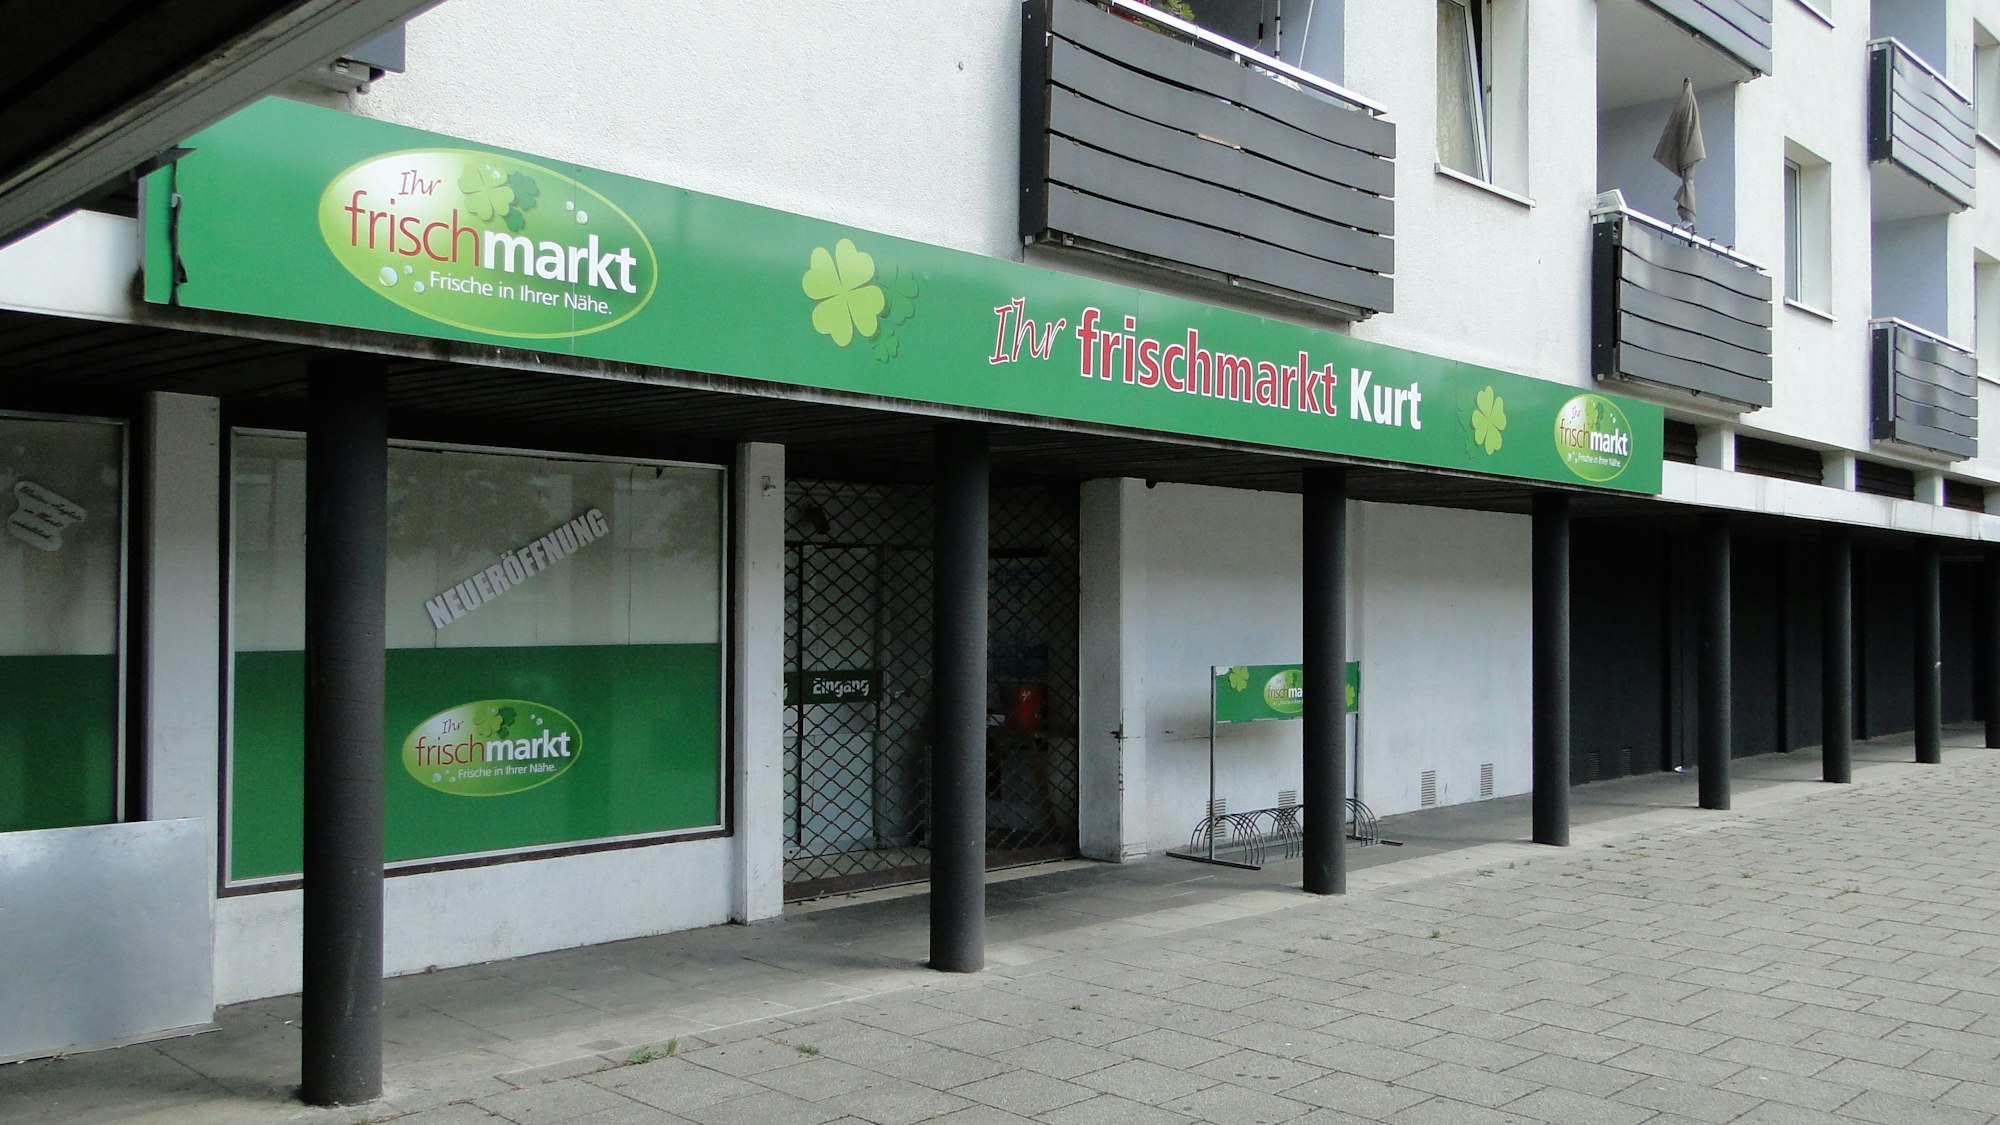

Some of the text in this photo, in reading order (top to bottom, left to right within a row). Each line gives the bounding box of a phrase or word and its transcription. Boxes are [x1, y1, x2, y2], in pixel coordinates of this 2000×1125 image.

[398, 170, 442, 196] Ihr
[344, 190, 637, 294] frischmarkt
[430, 271, 613, 315] Frische in Ihrer Nähe.
[988, 297, 1421, 430] Ihr frischmarkt Kurt
[1560, 418, 1628, 456] frischmarkt
[425, 508, 609, 629] NEUERÖFFNUNG
[812, 677, 870, 698] Eingang
[1268, 686, 1303, 699] frischma
[441, 718, 464, 735] Ihr
[415, 729, 571, 766] frischmarkt
[458, 763, 557, 779] Frische in Ihrer Nähe.
